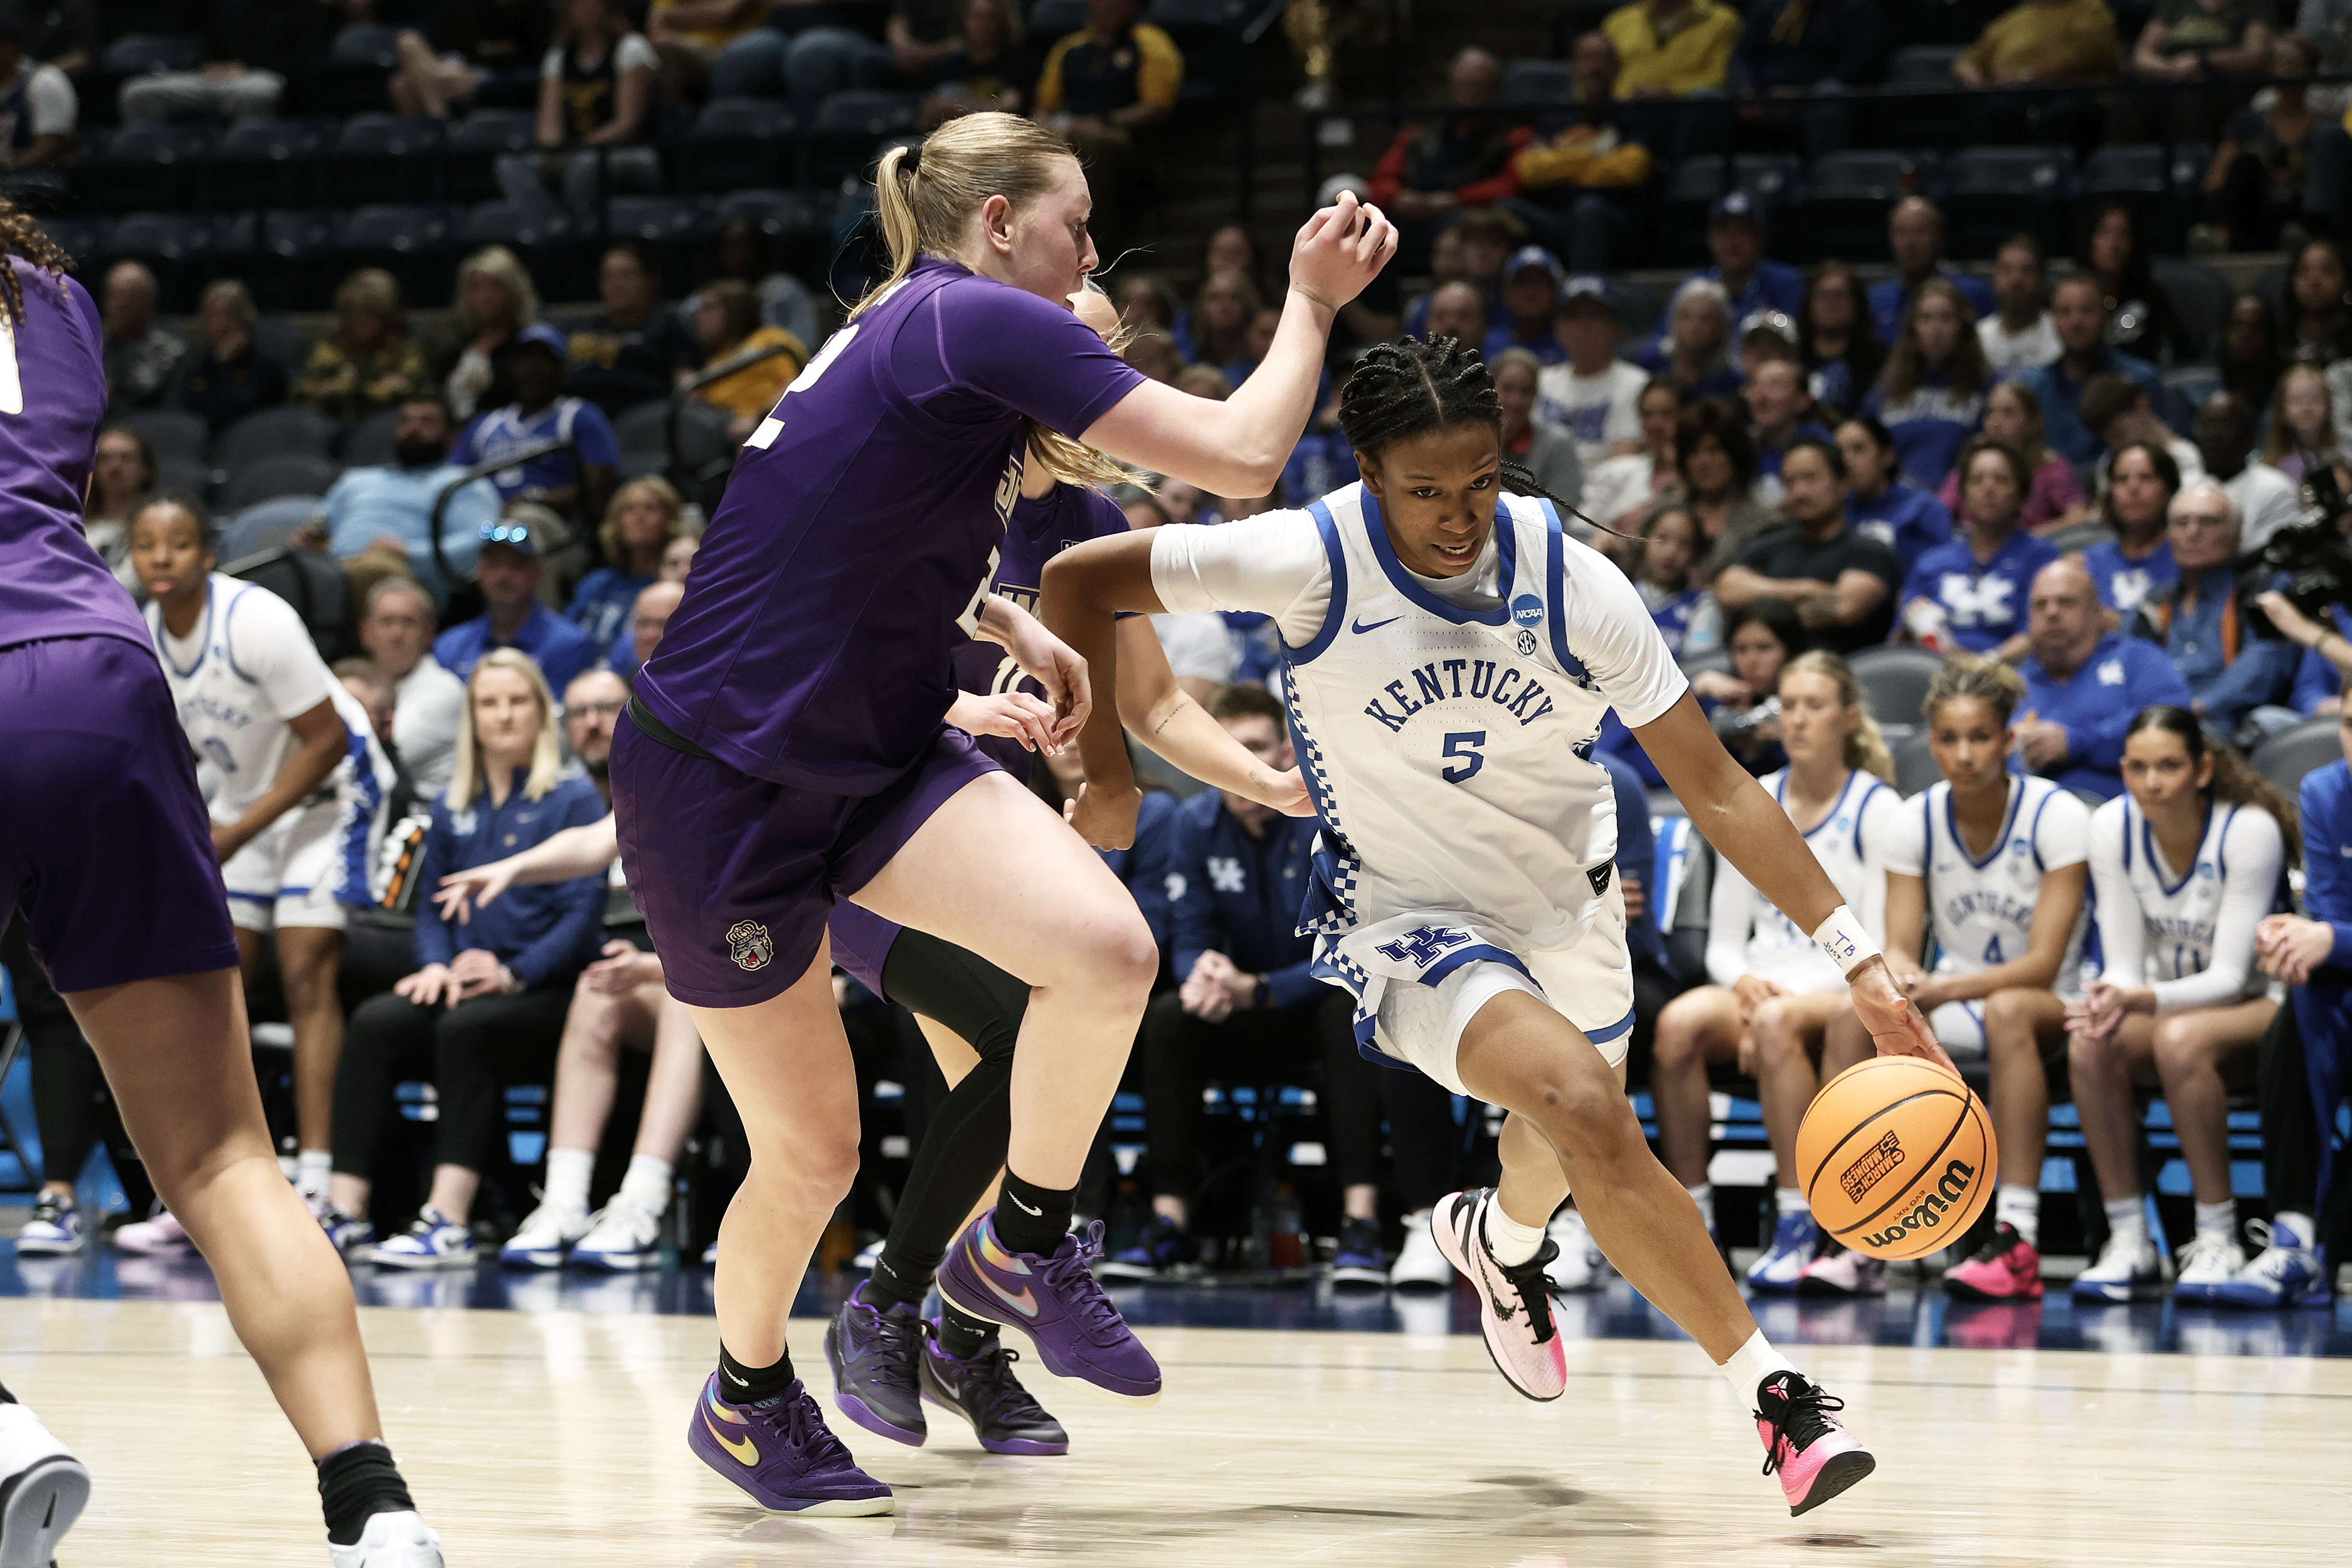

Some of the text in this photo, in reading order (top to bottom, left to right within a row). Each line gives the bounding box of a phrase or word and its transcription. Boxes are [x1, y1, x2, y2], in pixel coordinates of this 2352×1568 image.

[1516, 608, 1543, 619] NCAA
[1518, 631, 1536, 654] SEC
[1364, 659, 1554, 733] KENTUCKY
[1442, 730, 1486, 785] 5
[1374, 925, 1472, 969] UK
[1823, 941, 1842, 960] JUST
[1841, 1148, 1883, 1192] MADNESS
[1861, 1155, 1895, 1190] MARCH
[1860, 1159, 1975, 1248] Wilson
[1893, 1189, 1926, 1221] EVO NXT
